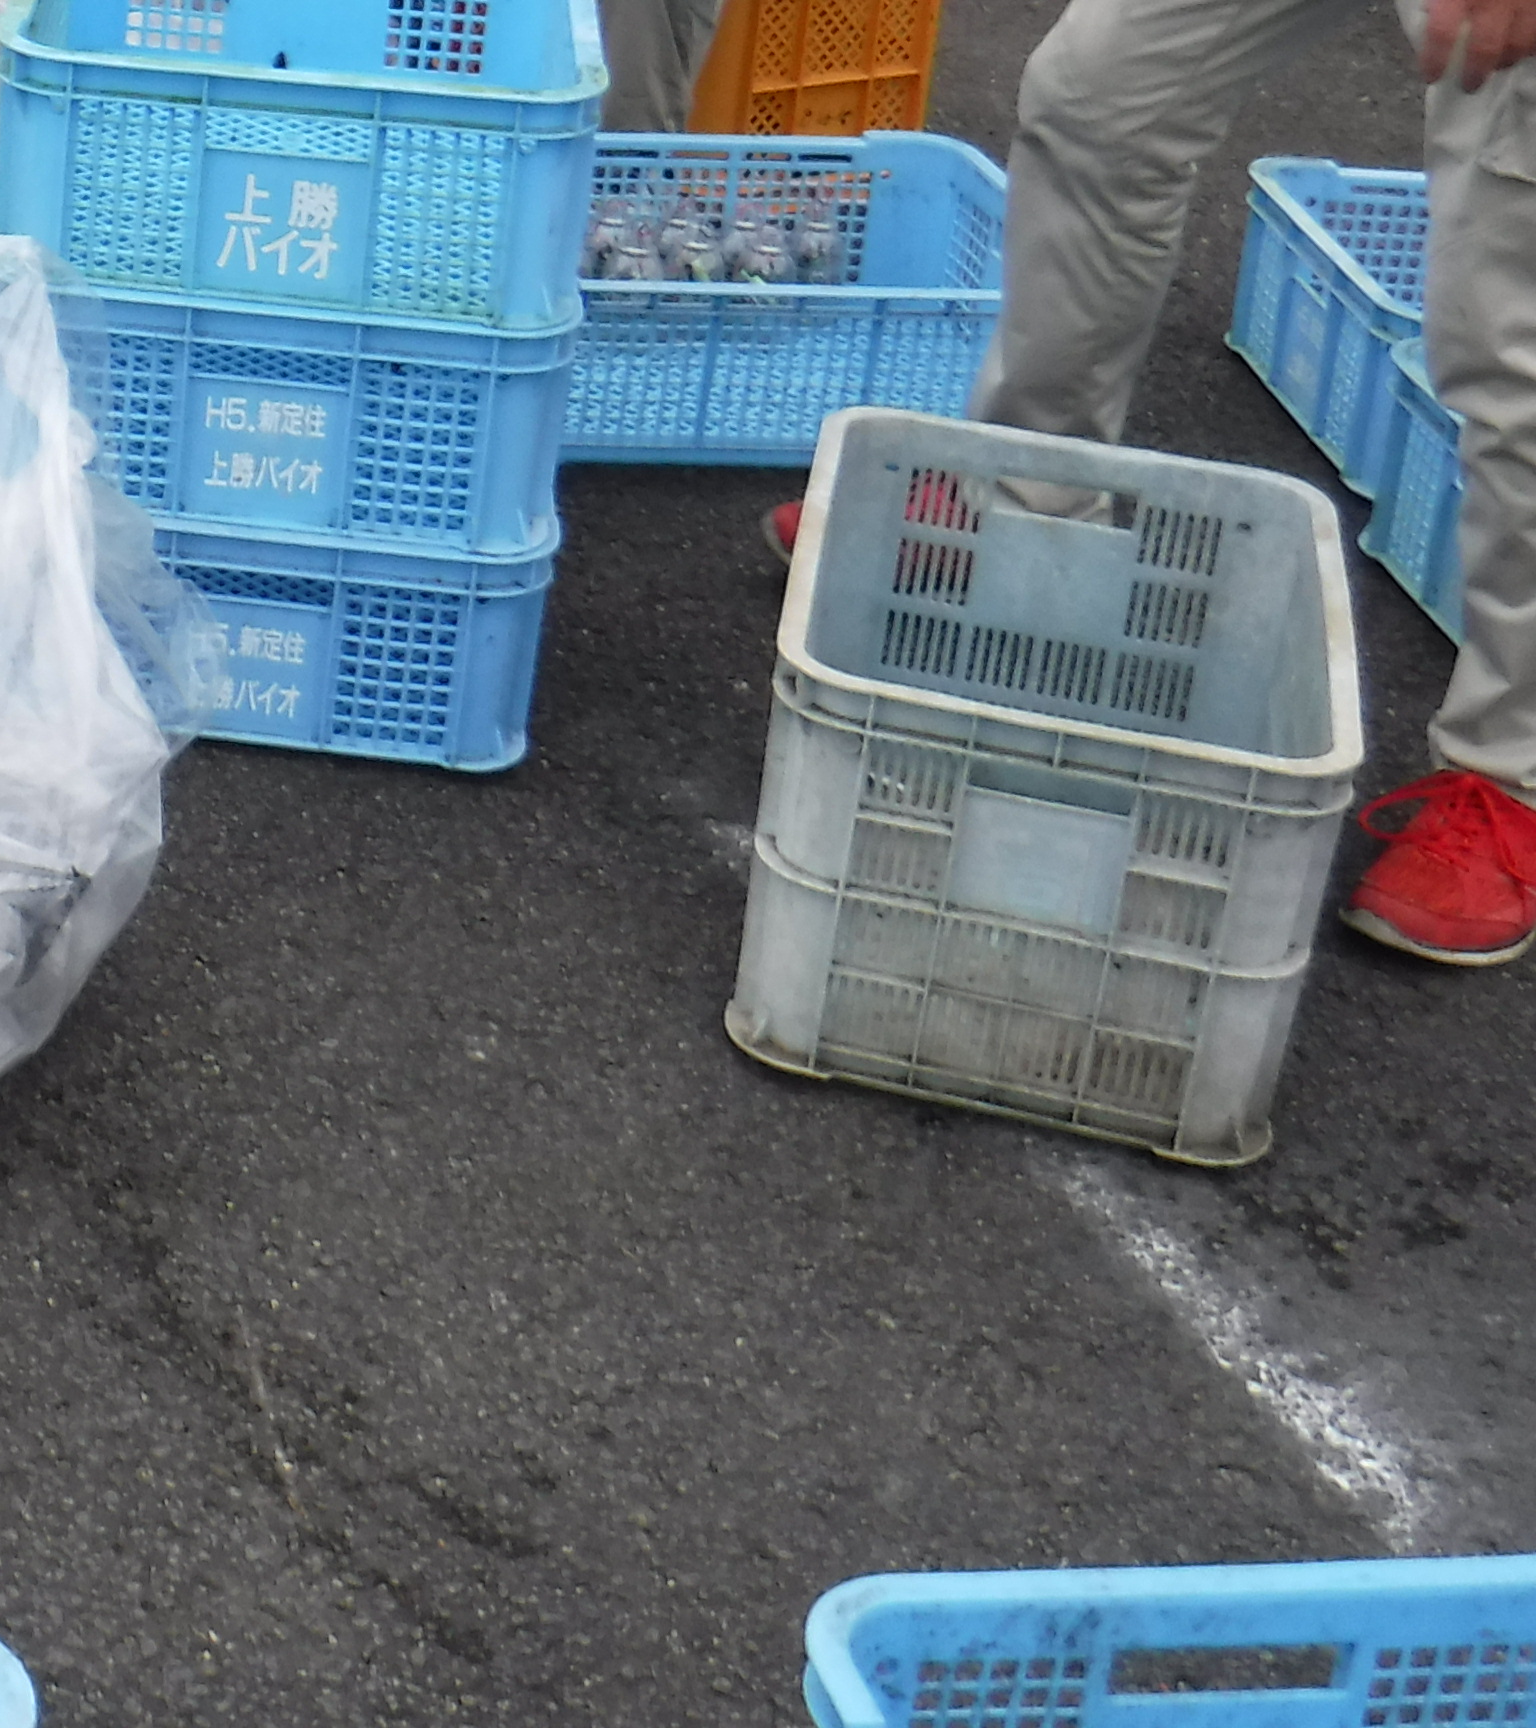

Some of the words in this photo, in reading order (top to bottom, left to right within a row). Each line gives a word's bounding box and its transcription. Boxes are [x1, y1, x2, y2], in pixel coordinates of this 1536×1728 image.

[224, 174, 337, 230] 上勝
[216, 225, 337, 278] バイオ
[204, 450, 323, 494] 上勝バイオ
[190, 674, 300, 719] 勝バイオ
